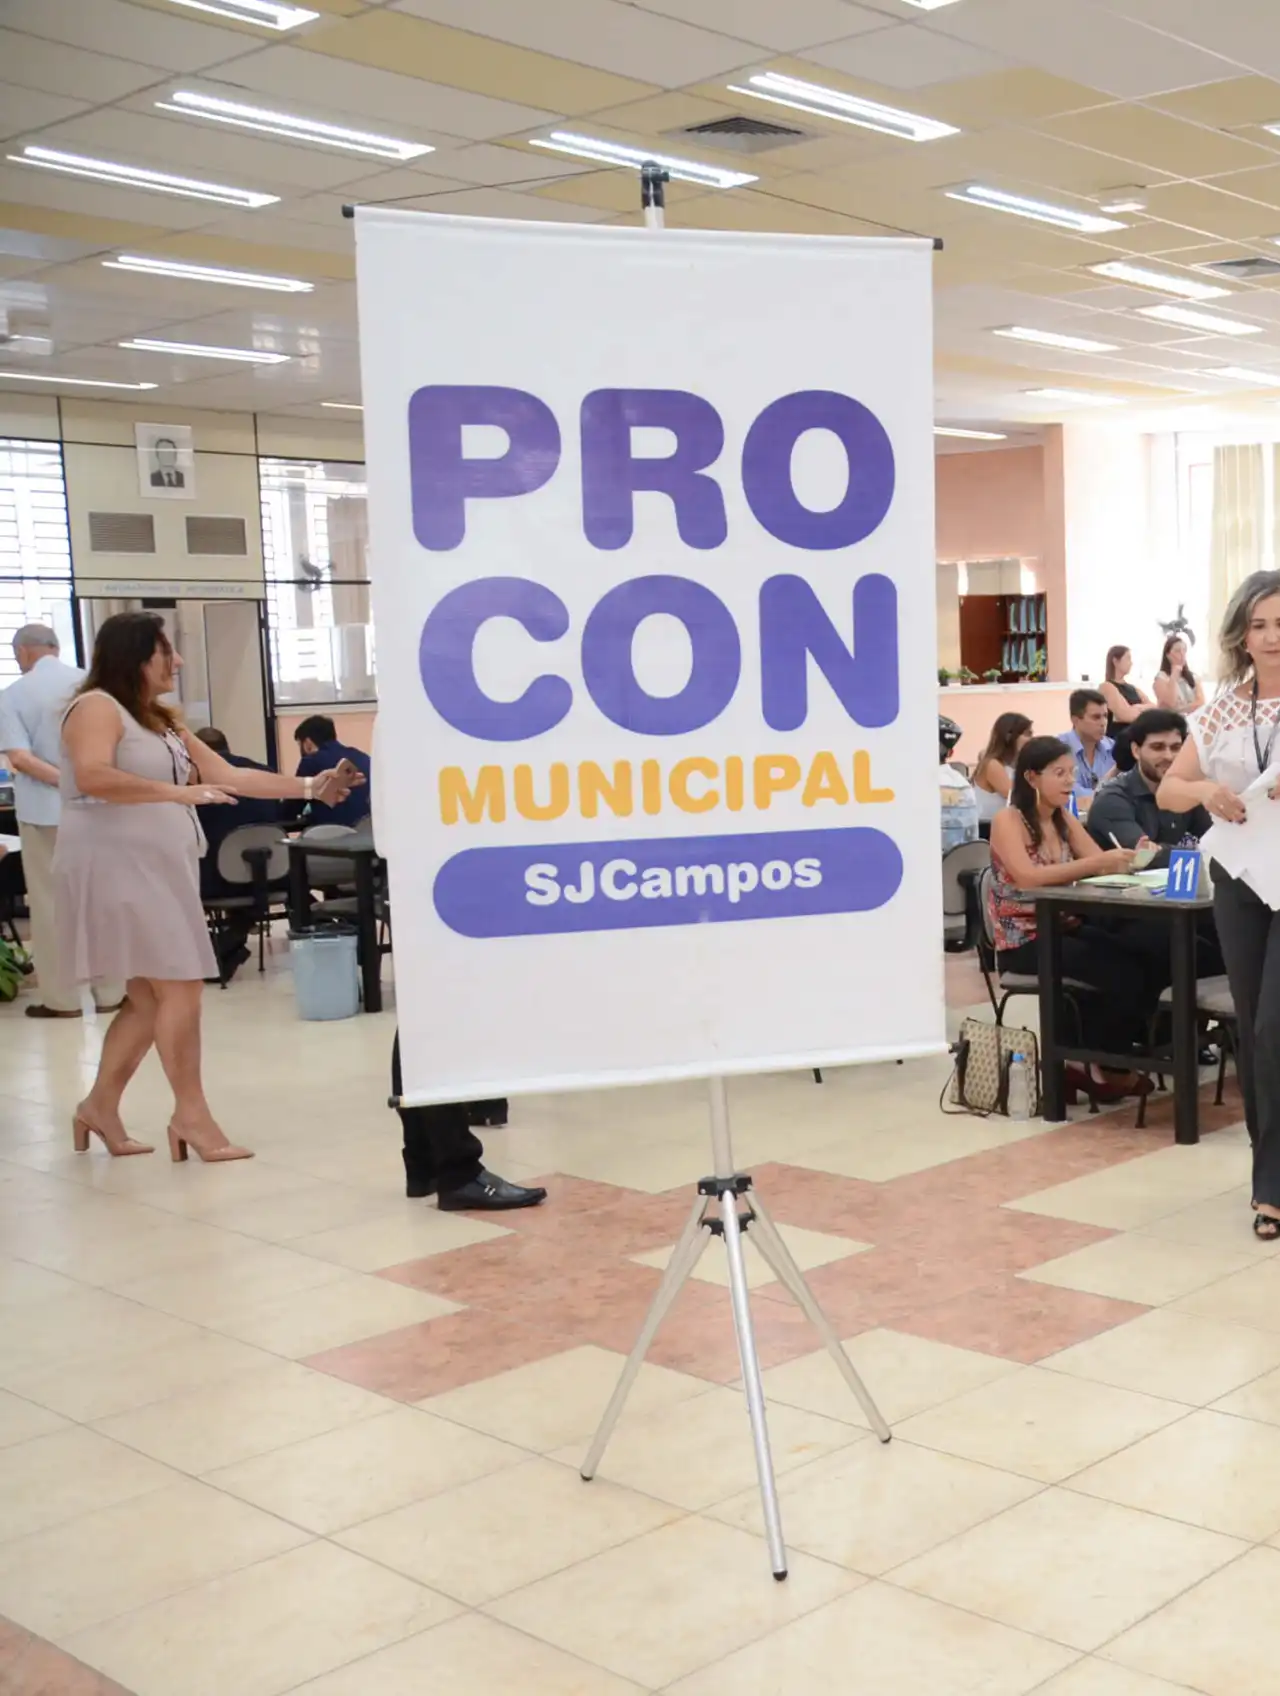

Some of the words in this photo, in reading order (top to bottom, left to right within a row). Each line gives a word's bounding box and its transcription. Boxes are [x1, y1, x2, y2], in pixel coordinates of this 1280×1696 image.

[408, 385, 895, 551] PRO
[419, 573, 900, 742] CON
[438, 750, 895, 825] MUNICIPAL
[524, 857, 823, 905] SJCampos
[1172, 857, 1195, 892] 11
